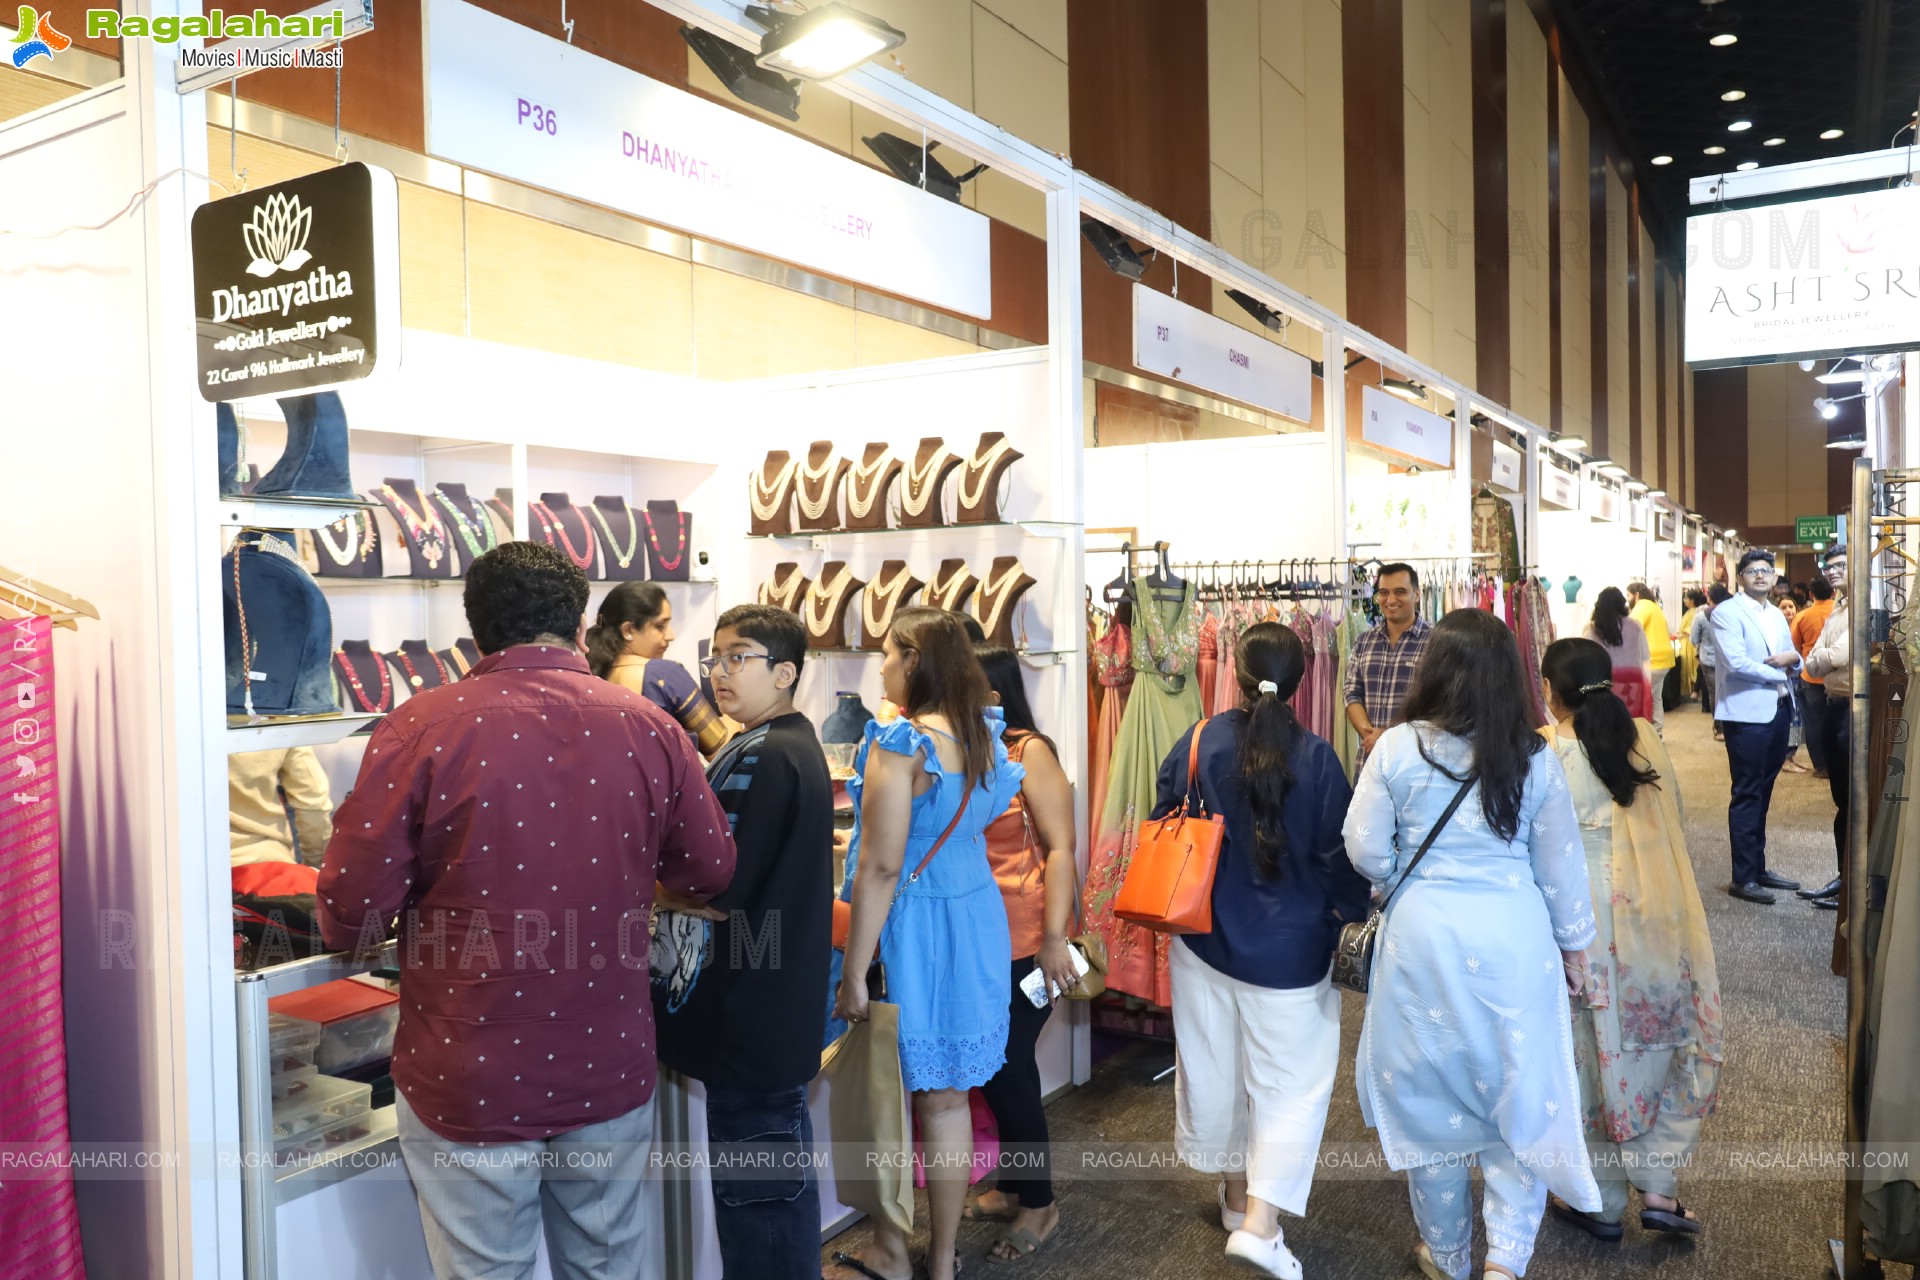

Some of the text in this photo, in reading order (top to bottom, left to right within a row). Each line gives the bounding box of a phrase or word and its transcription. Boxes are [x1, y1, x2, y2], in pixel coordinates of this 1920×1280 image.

[516, 97, 558, 136] P36
[212, 265, 353, 323] Dhanyatha
[1157, 325, 1169, 341] P37
[1754, 310, 1870, 328] BRIDAL JEWELLERY
[235, 320, 328, 351] Gold Jewellery
[206, 369, 221, 385] 22
[250, 360, 268, 378] 916
[269, 354, 316, 374] Hallmark
[316, 346, 365, 367] Jewellery
[1800, 527, 1831, 537] EXIT
